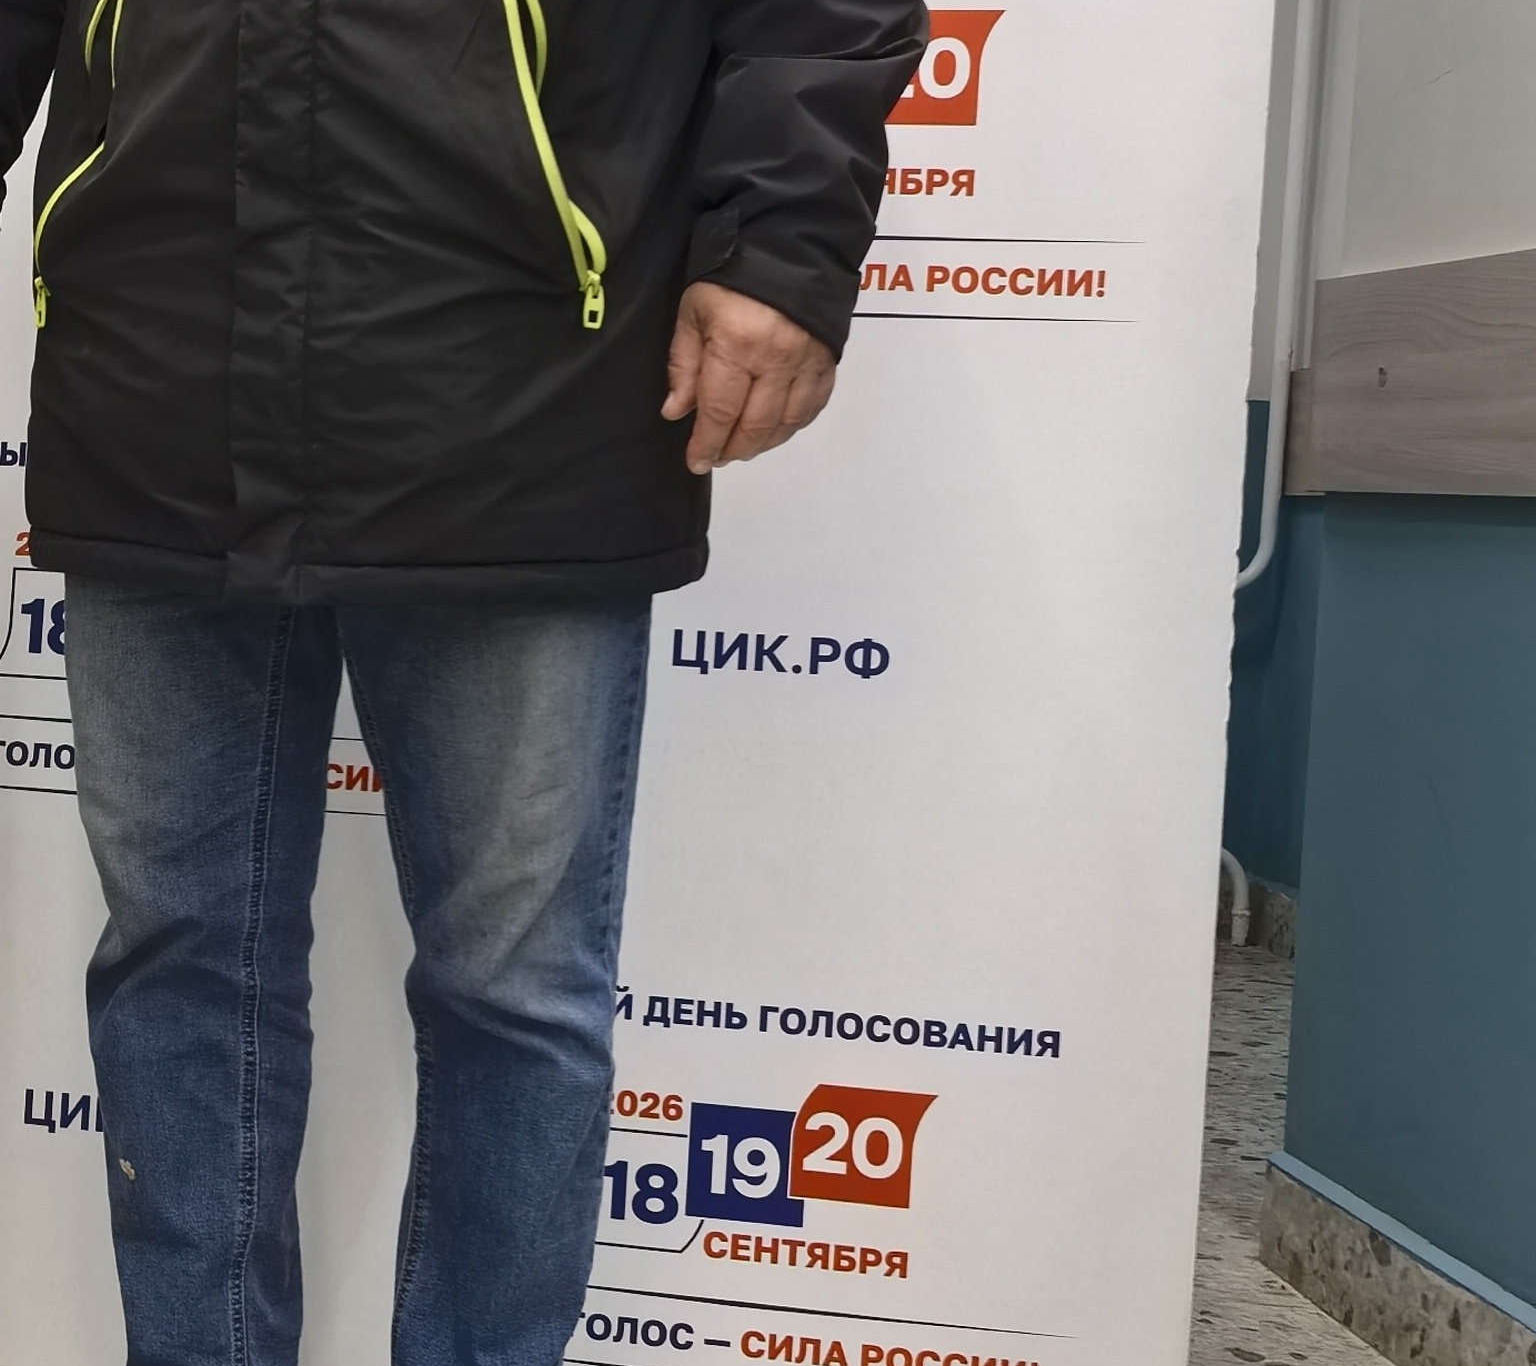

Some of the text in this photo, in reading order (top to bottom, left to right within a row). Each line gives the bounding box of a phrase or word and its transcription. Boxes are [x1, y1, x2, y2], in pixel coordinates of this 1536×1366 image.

[901, 37, 971, 99] 0
[859, 263, 1106, 298] ЛА РОССИИ!
[671, 628, 890, 680] ЦИК.РФ
[642, 995, 748, 1030] ДЕНЬ
[759, 1005, 1061, 1059] ГОЛОСОВАНИЯ
[701, 1134, 781, 1199] 19
[802, 1112, 904, 1179] 20
[604, 1160, 679, 1225] 18
[703, 1230, 909, 1279] СЕНТЯБРЯ
[580, 1312, 695, 1351] ОЛОС
